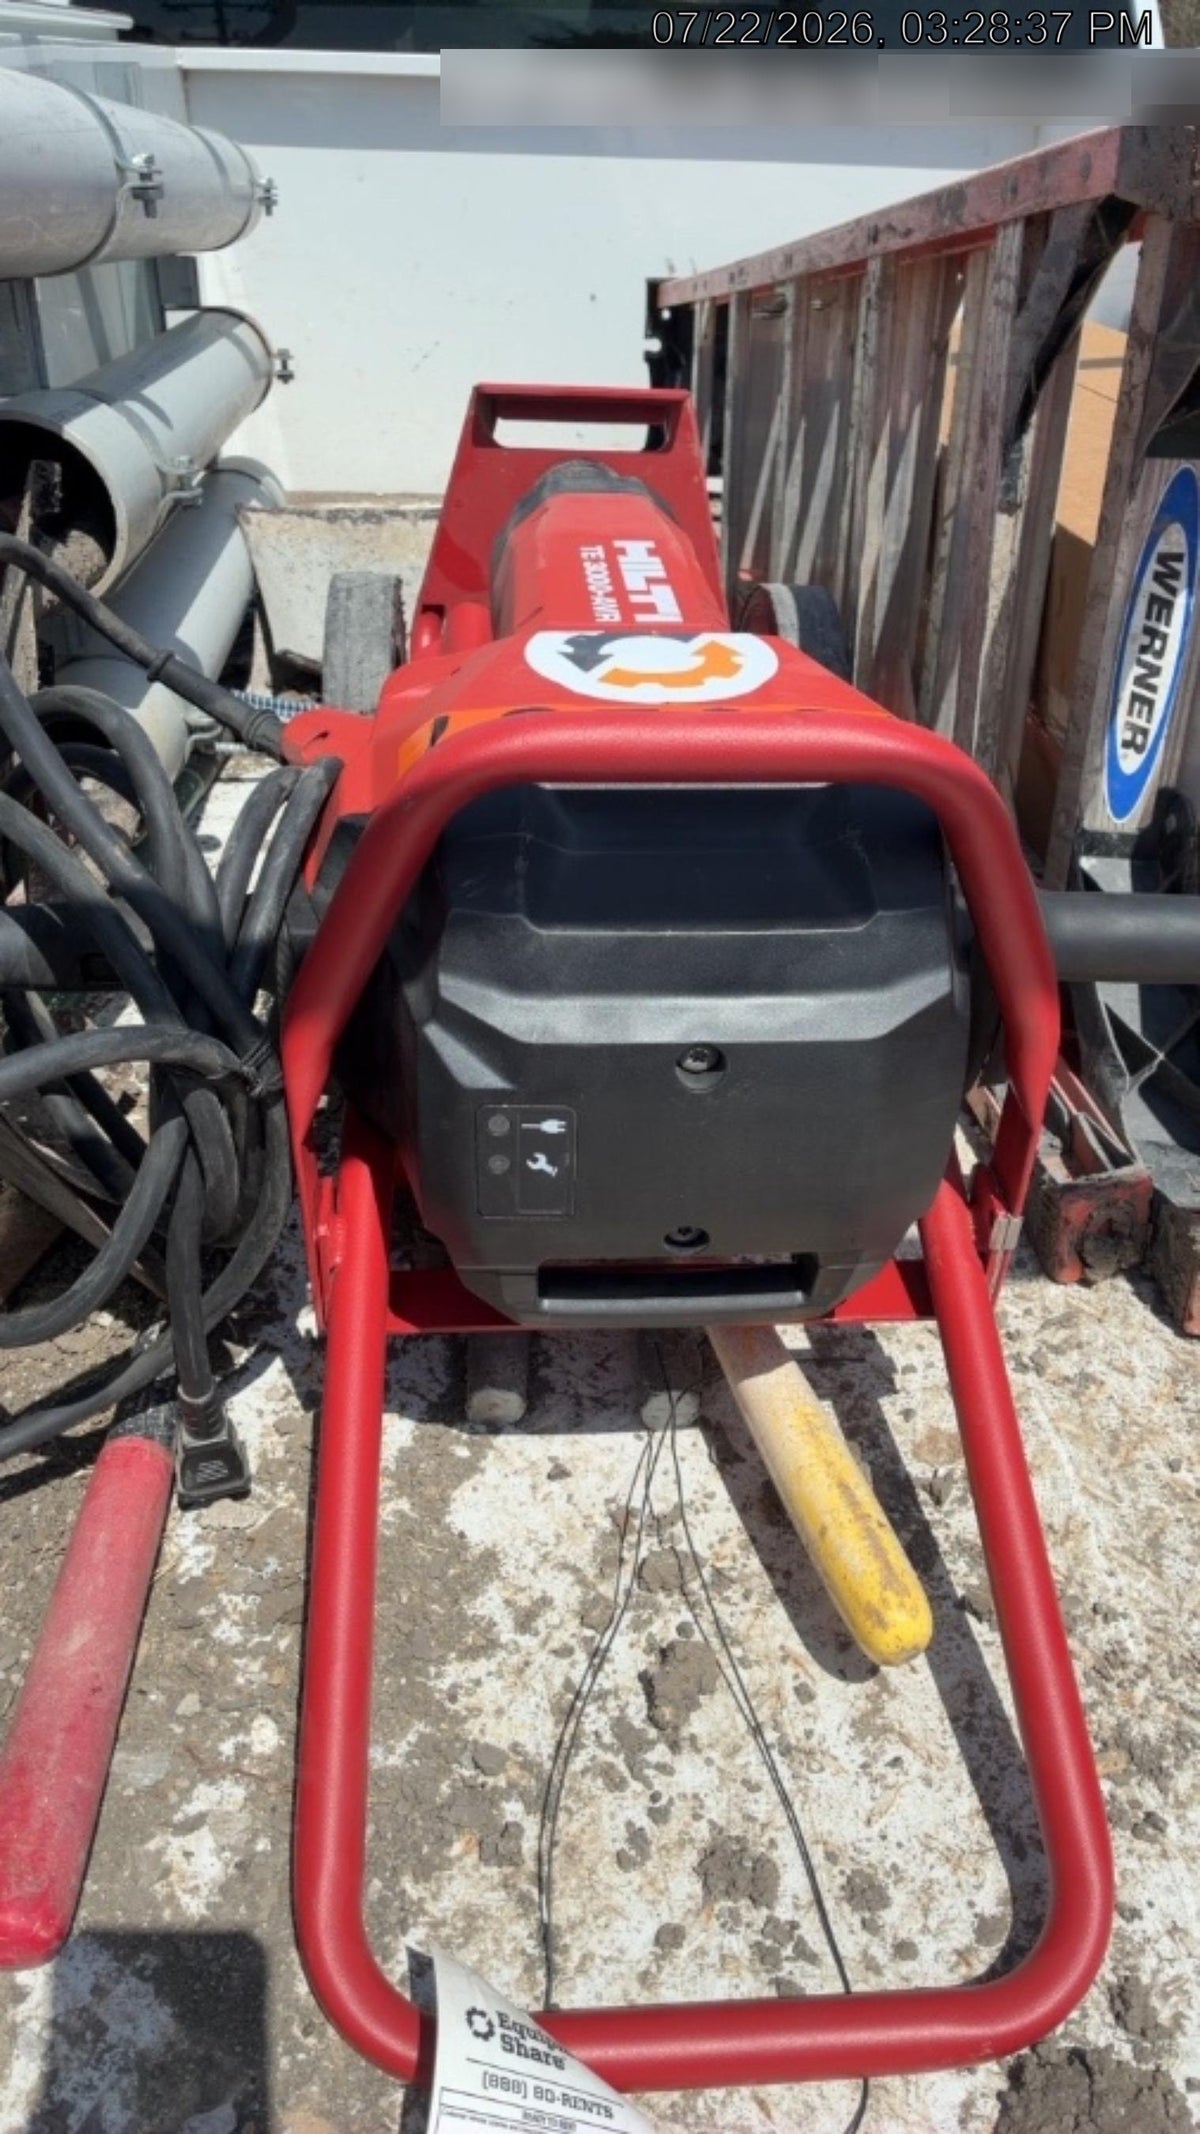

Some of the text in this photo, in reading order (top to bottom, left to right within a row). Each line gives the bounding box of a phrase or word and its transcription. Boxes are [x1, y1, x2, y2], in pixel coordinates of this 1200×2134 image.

[612, 540, 684, 622] HILTI
[1121, 552, 1185, 755] WERNER
[500, 2033, 566, 2071] Share
